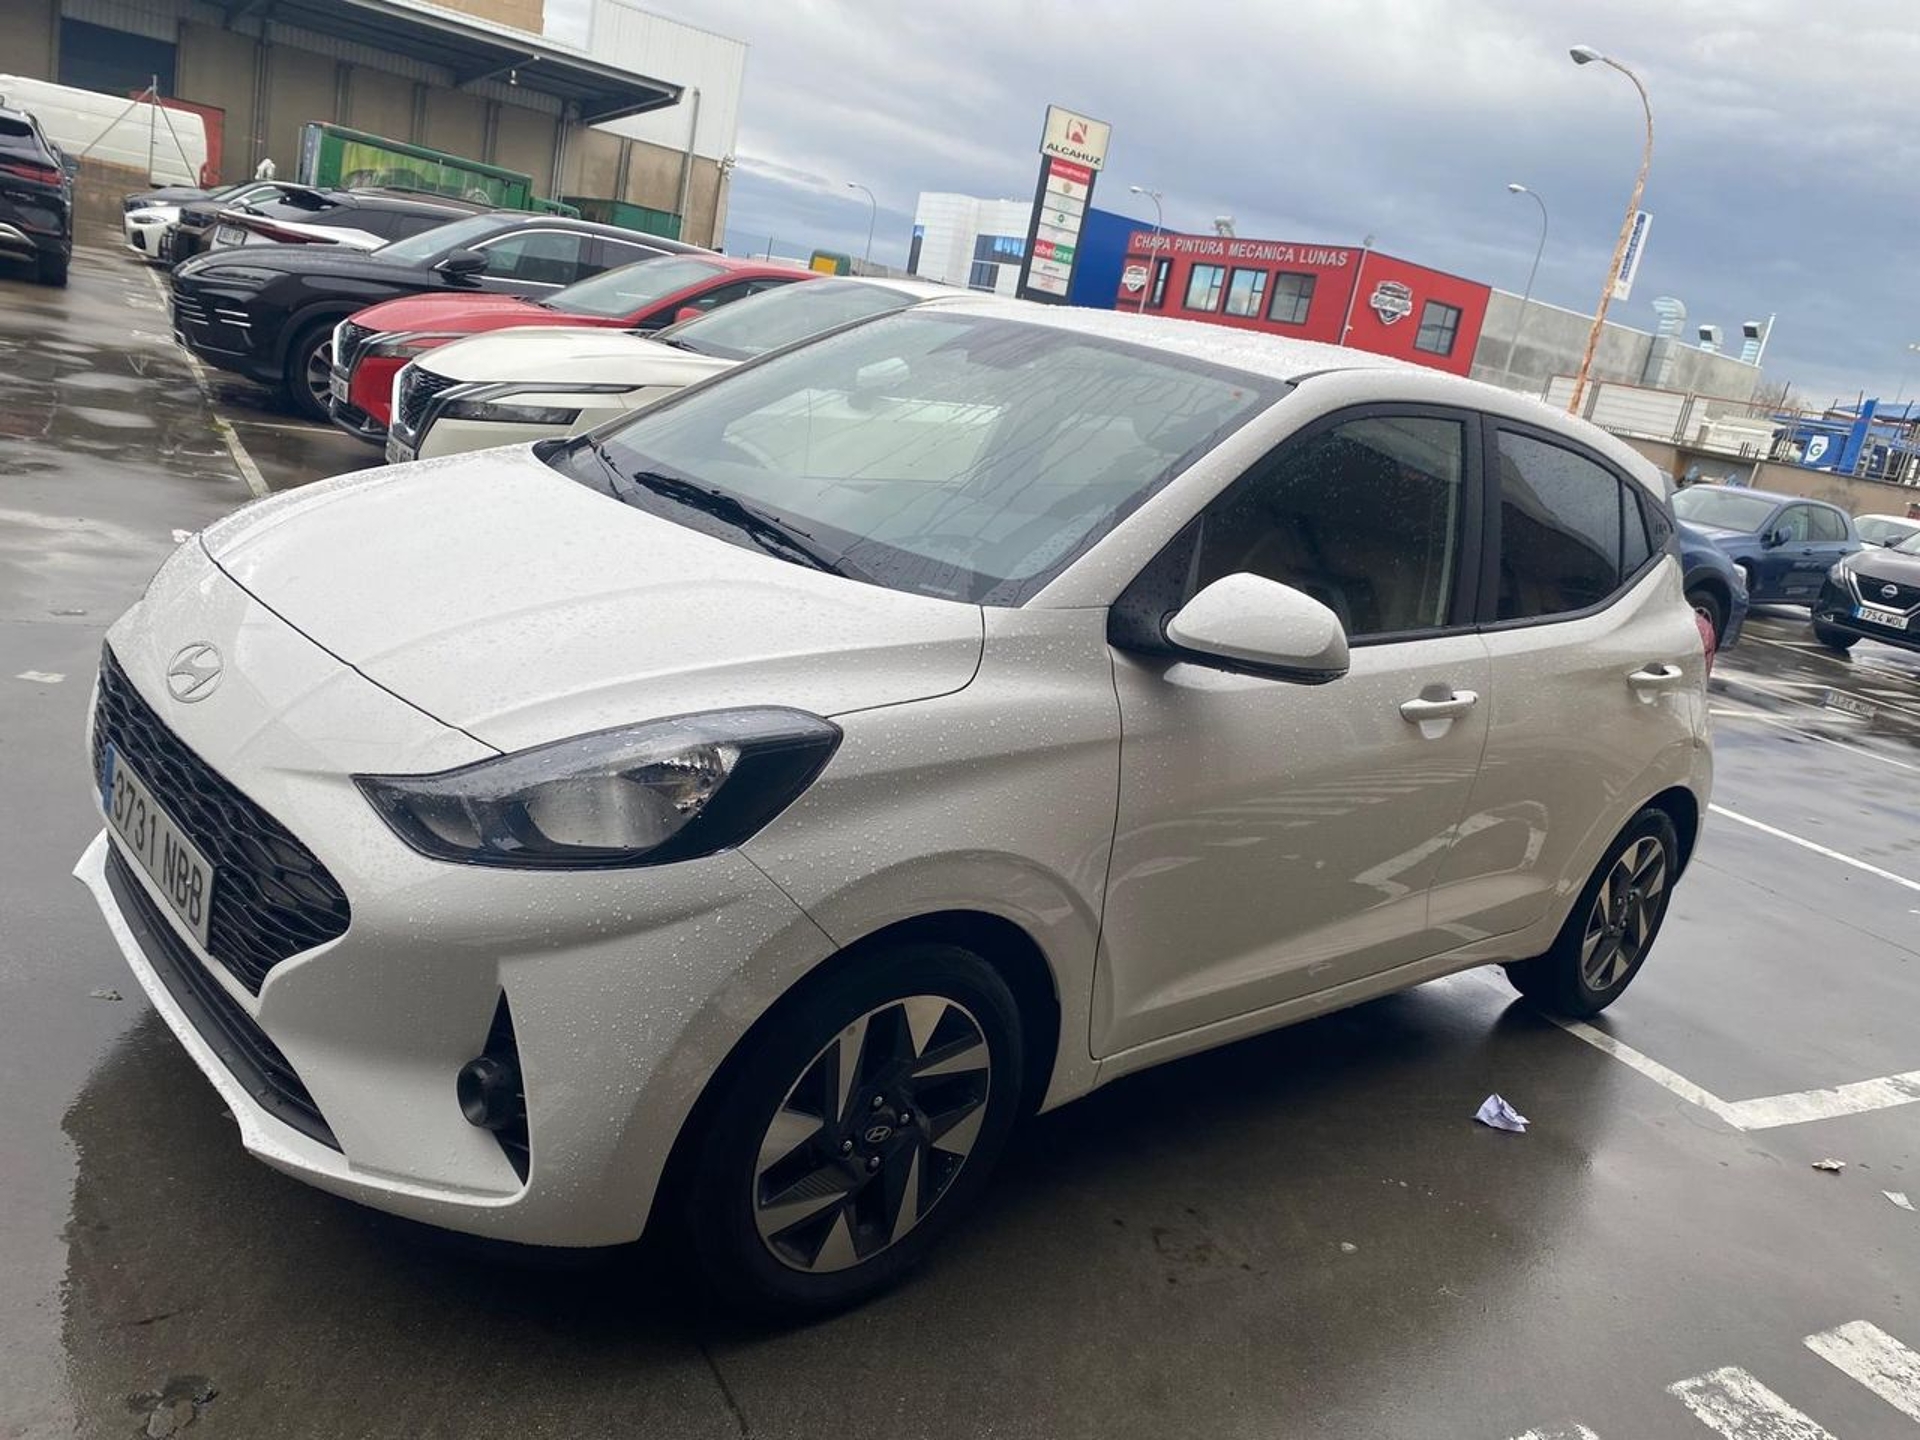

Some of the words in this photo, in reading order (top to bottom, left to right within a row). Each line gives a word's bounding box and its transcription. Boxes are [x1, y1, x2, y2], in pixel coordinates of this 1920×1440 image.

[1046, 143, 1102, 166] ALCAHUZ
[1134, 235, 1171, 251] CHAPA
[1174, 239, 1224, 255] PINTURA
[1228, 243, 1294, 262] MECANICA
[1299, 249, 1349, 266] LUNAS
[113, 769, 157, 867] 3731
[162, 831, 204, 927] NBB
